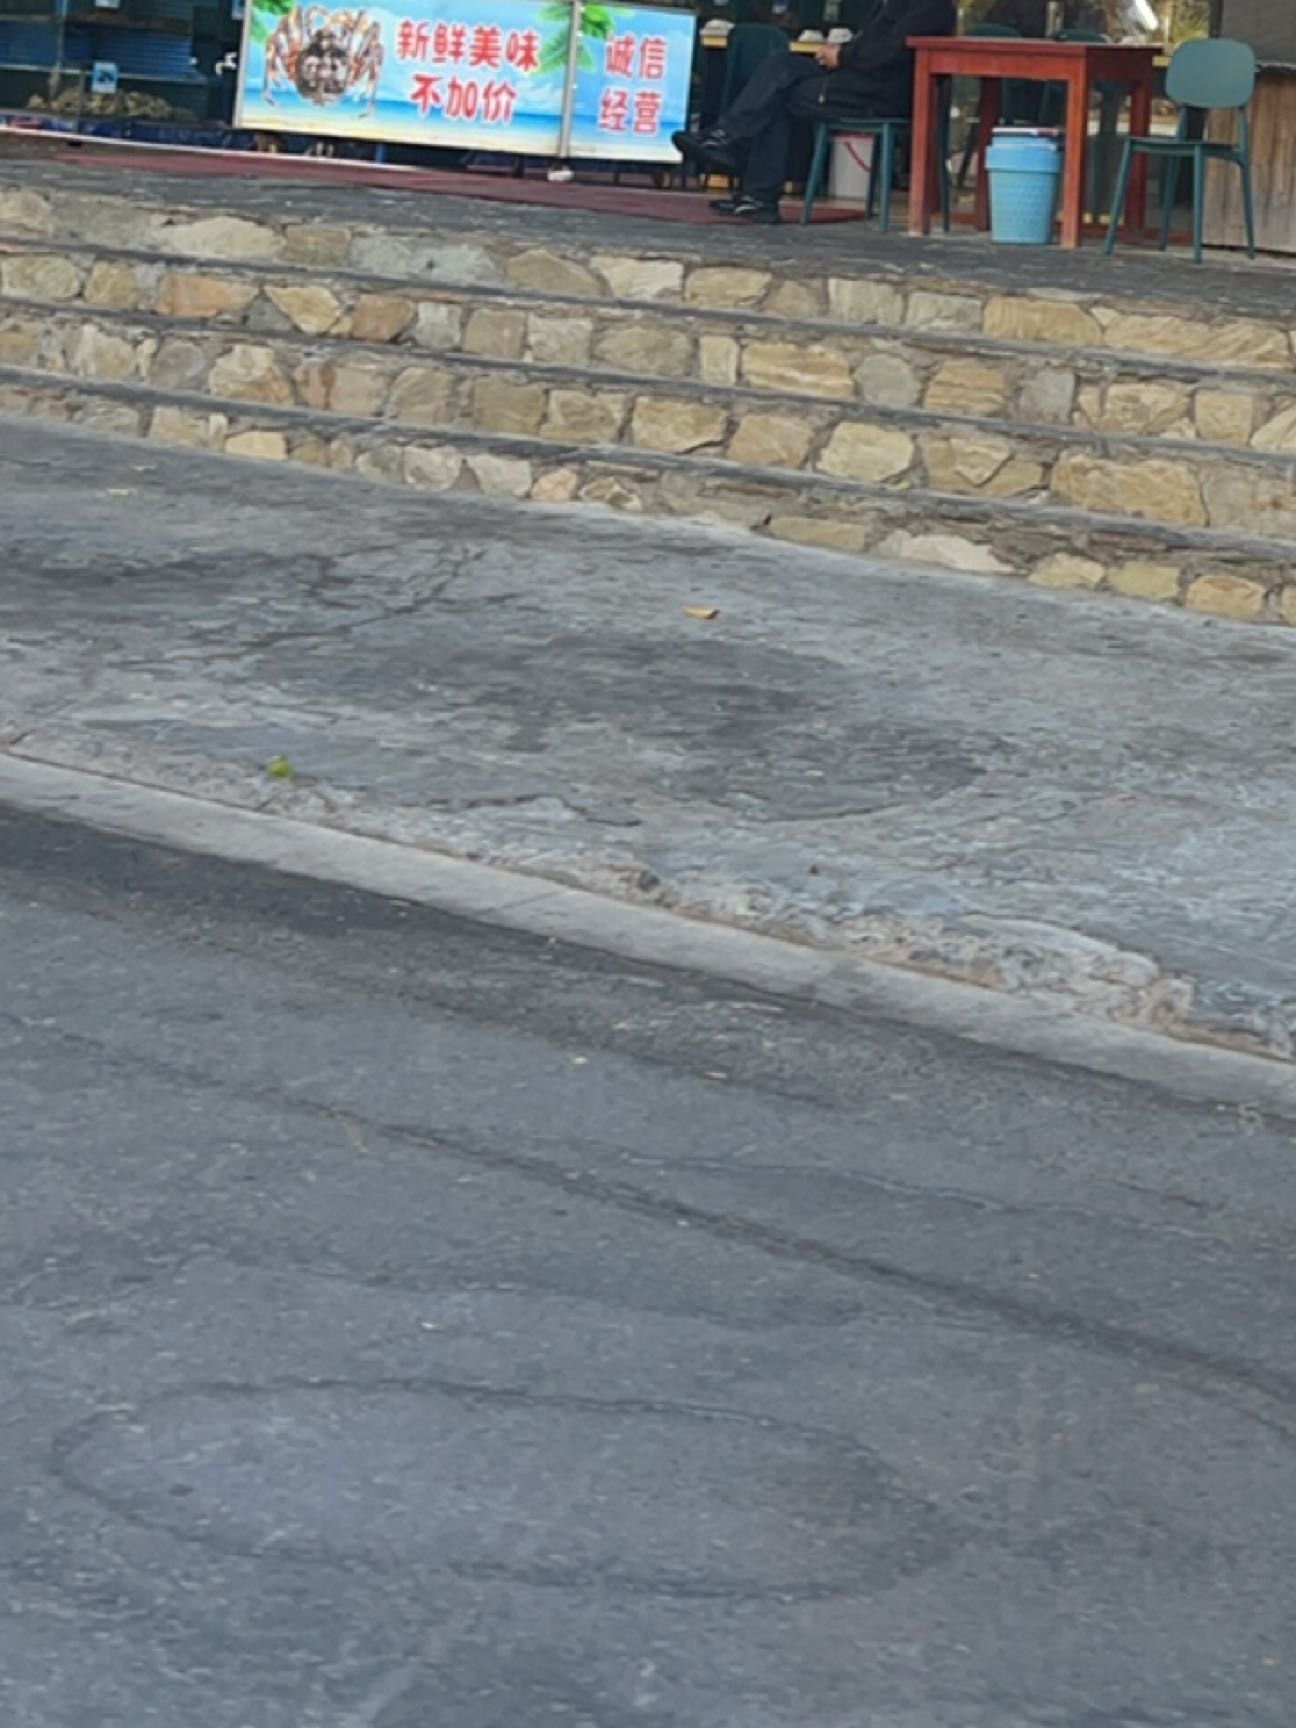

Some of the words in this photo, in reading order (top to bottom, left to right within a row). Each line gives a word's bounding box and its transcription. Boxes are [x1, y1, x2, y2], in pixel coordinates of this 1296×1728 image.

[396, 19, 539, 72] 新鲜美味
[606, 33, 667, 80] 诚信
[410, 72, 518, 124] 不加价
[598, 86, 662, 134] 经营
